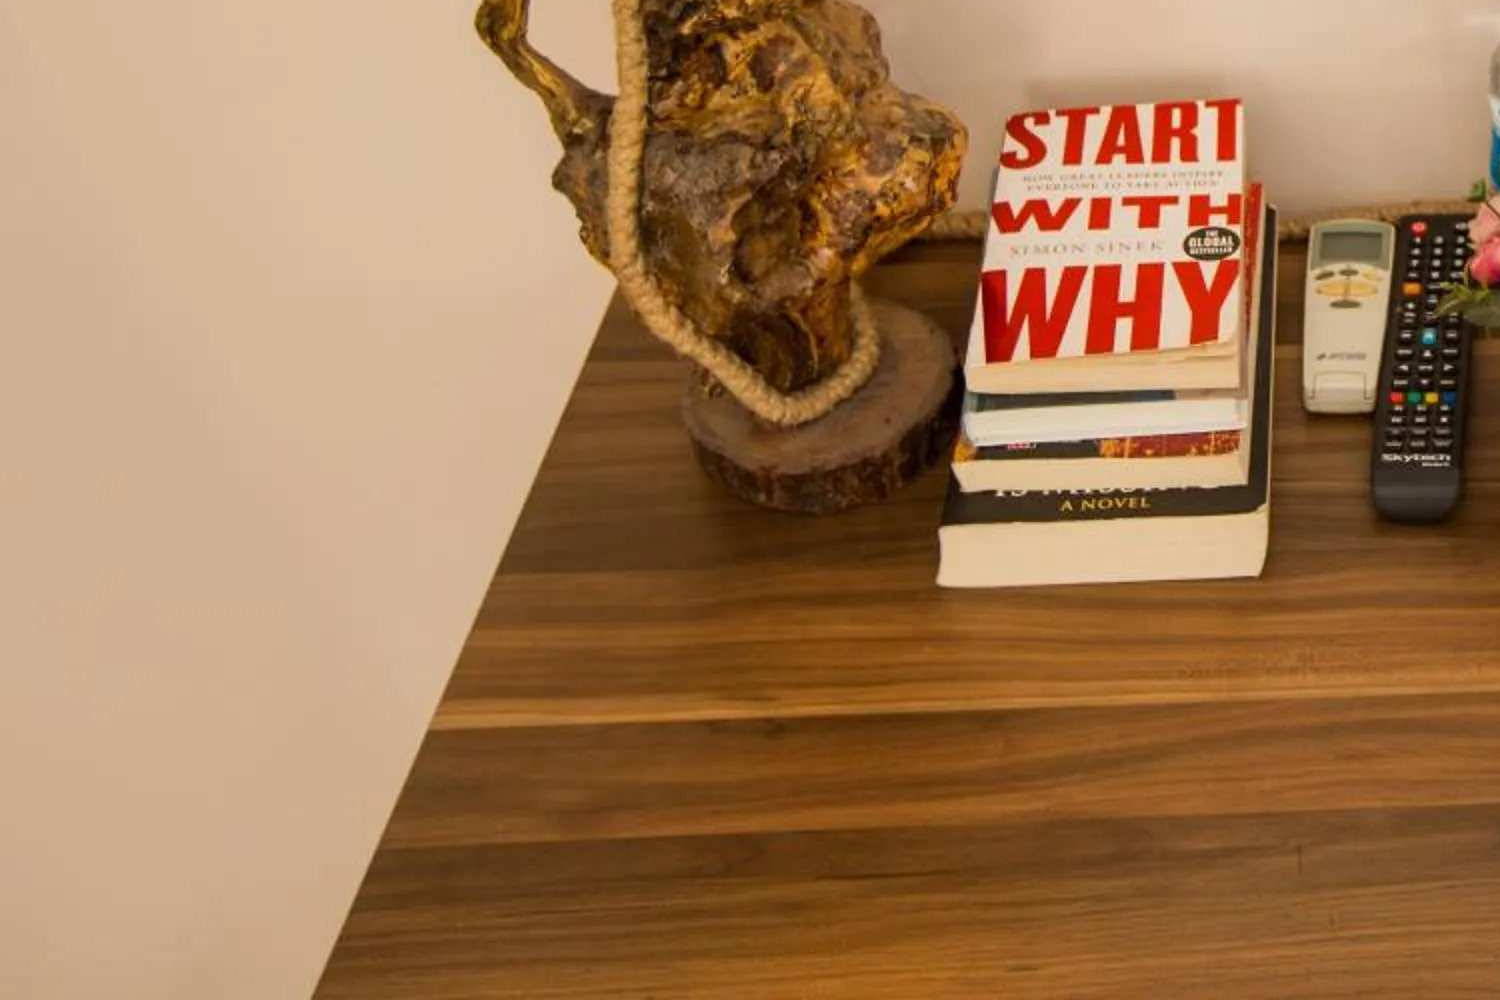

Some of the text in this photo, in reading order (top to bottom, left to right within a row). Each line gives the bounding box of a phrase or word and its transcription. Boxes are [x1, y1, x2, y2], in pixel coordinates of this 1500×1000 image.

[1000, 98, 1242, 170] START
[990, 193, 1243, 234] WITH
[1009, 239, 1164, 256] SIMON SINEK
[1188, 235, 1235, 247] GLOBAL
[981, 258, 1241, 365] WHY
[1060, 496, 1152, 512] A NOVEL
